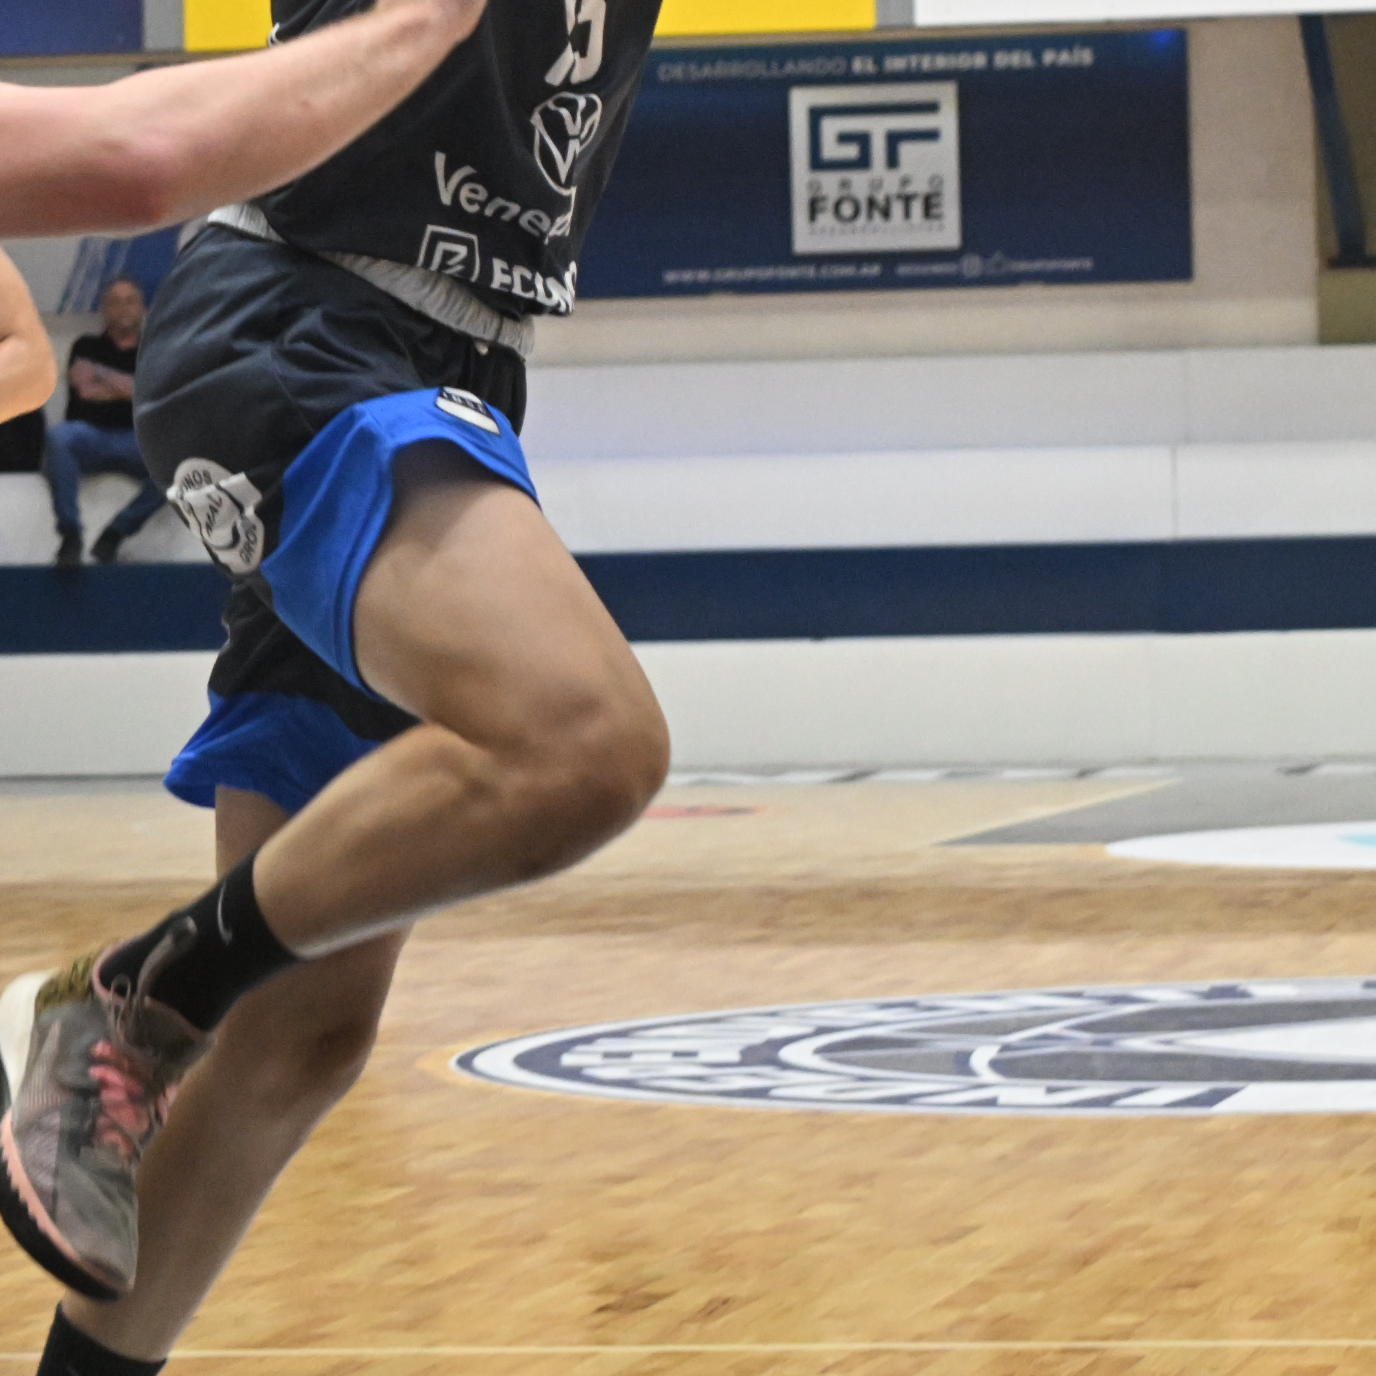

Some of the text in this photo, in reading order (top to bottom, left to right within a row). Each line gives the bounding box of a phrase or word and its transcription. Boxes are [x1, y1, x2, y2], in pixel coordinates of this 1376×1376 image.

[658, 44, 1095, 82] DESARROLLANDO EL INTERIOR DEL PAÍS
[808, 191, 945, 223] FONTE
